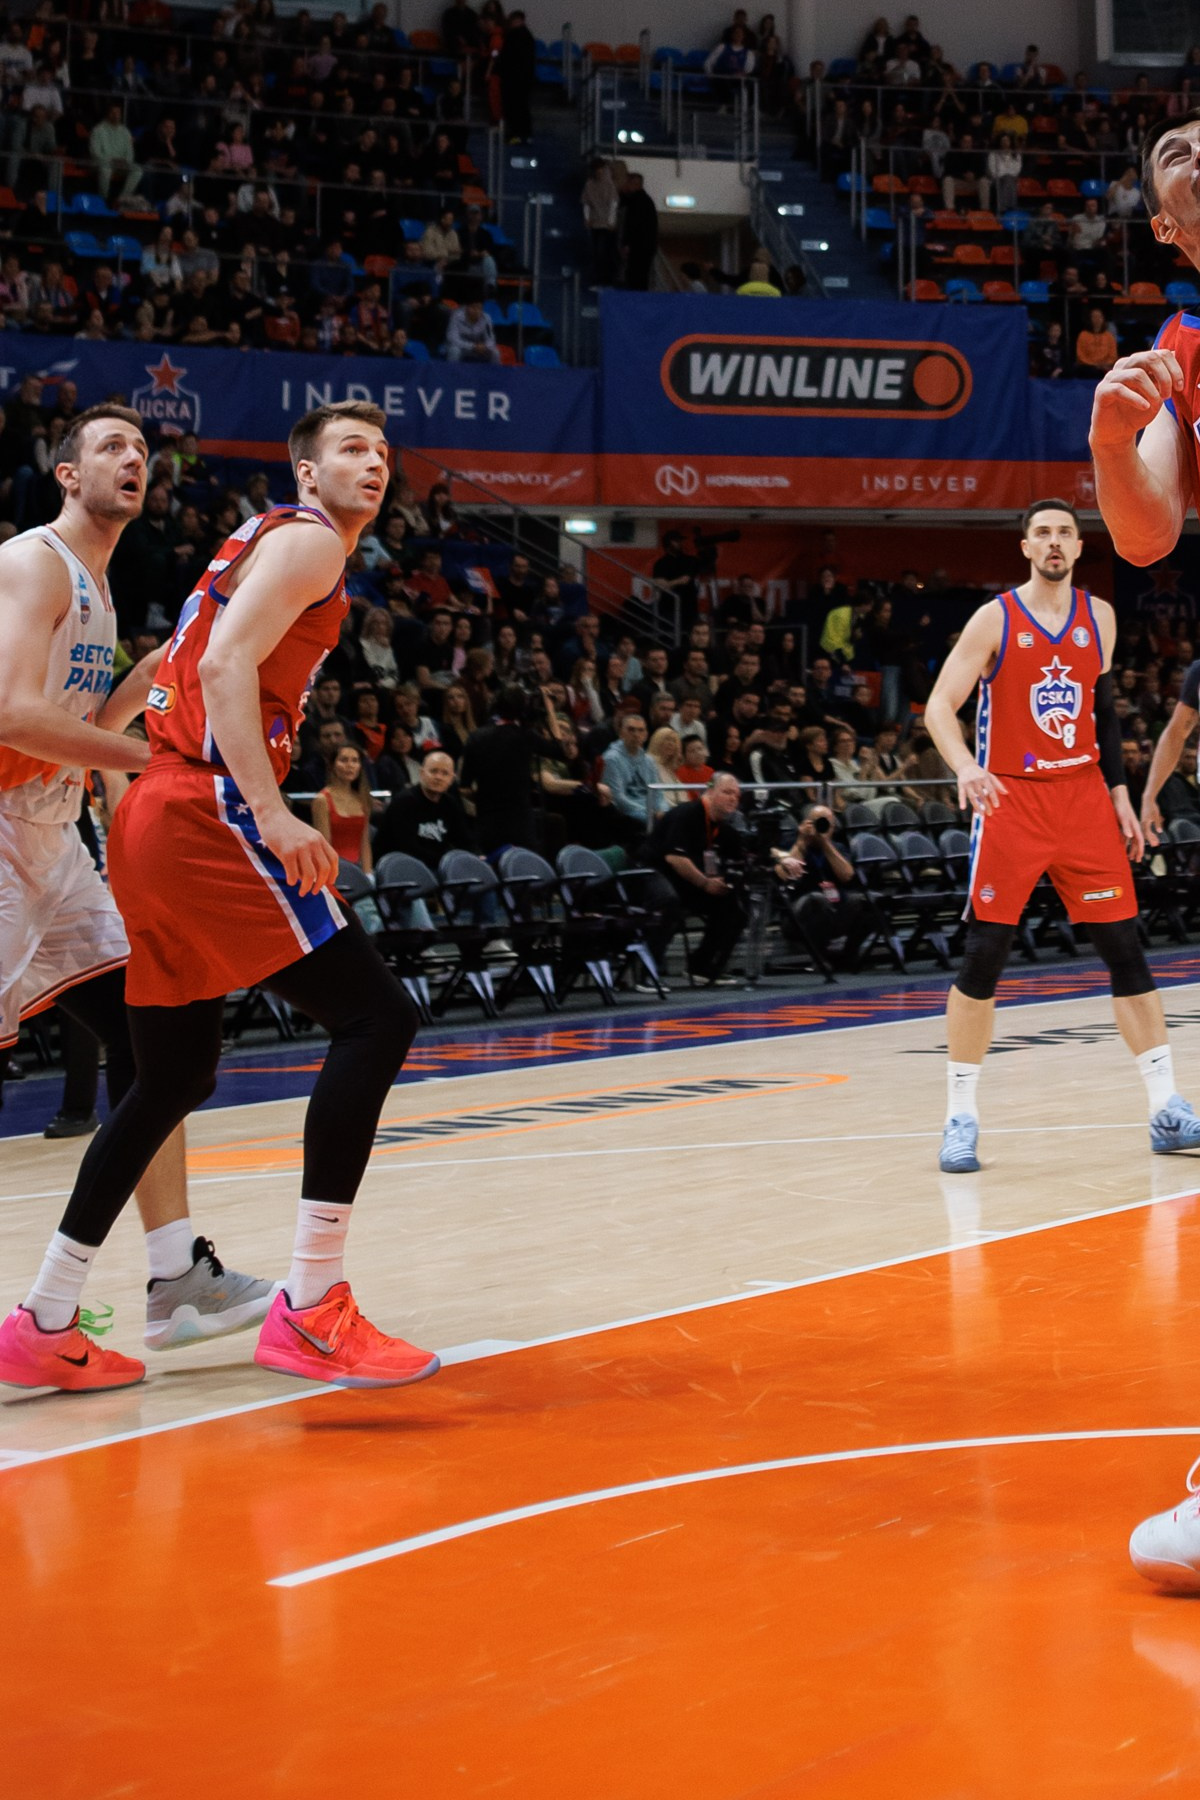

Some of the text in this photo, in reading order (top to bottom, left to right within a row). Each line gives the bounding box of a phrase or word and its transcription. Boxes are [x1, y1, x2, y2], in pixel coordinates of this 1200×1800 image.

[688, 351, 906, 401] WINLINE
[139, 398, 192, 421] ЦСКА
[861, 474, 978, 493] INDEVER
[1037, 690, 1075, 706] CSKA
[1062, 723, 1077, 749] 8
